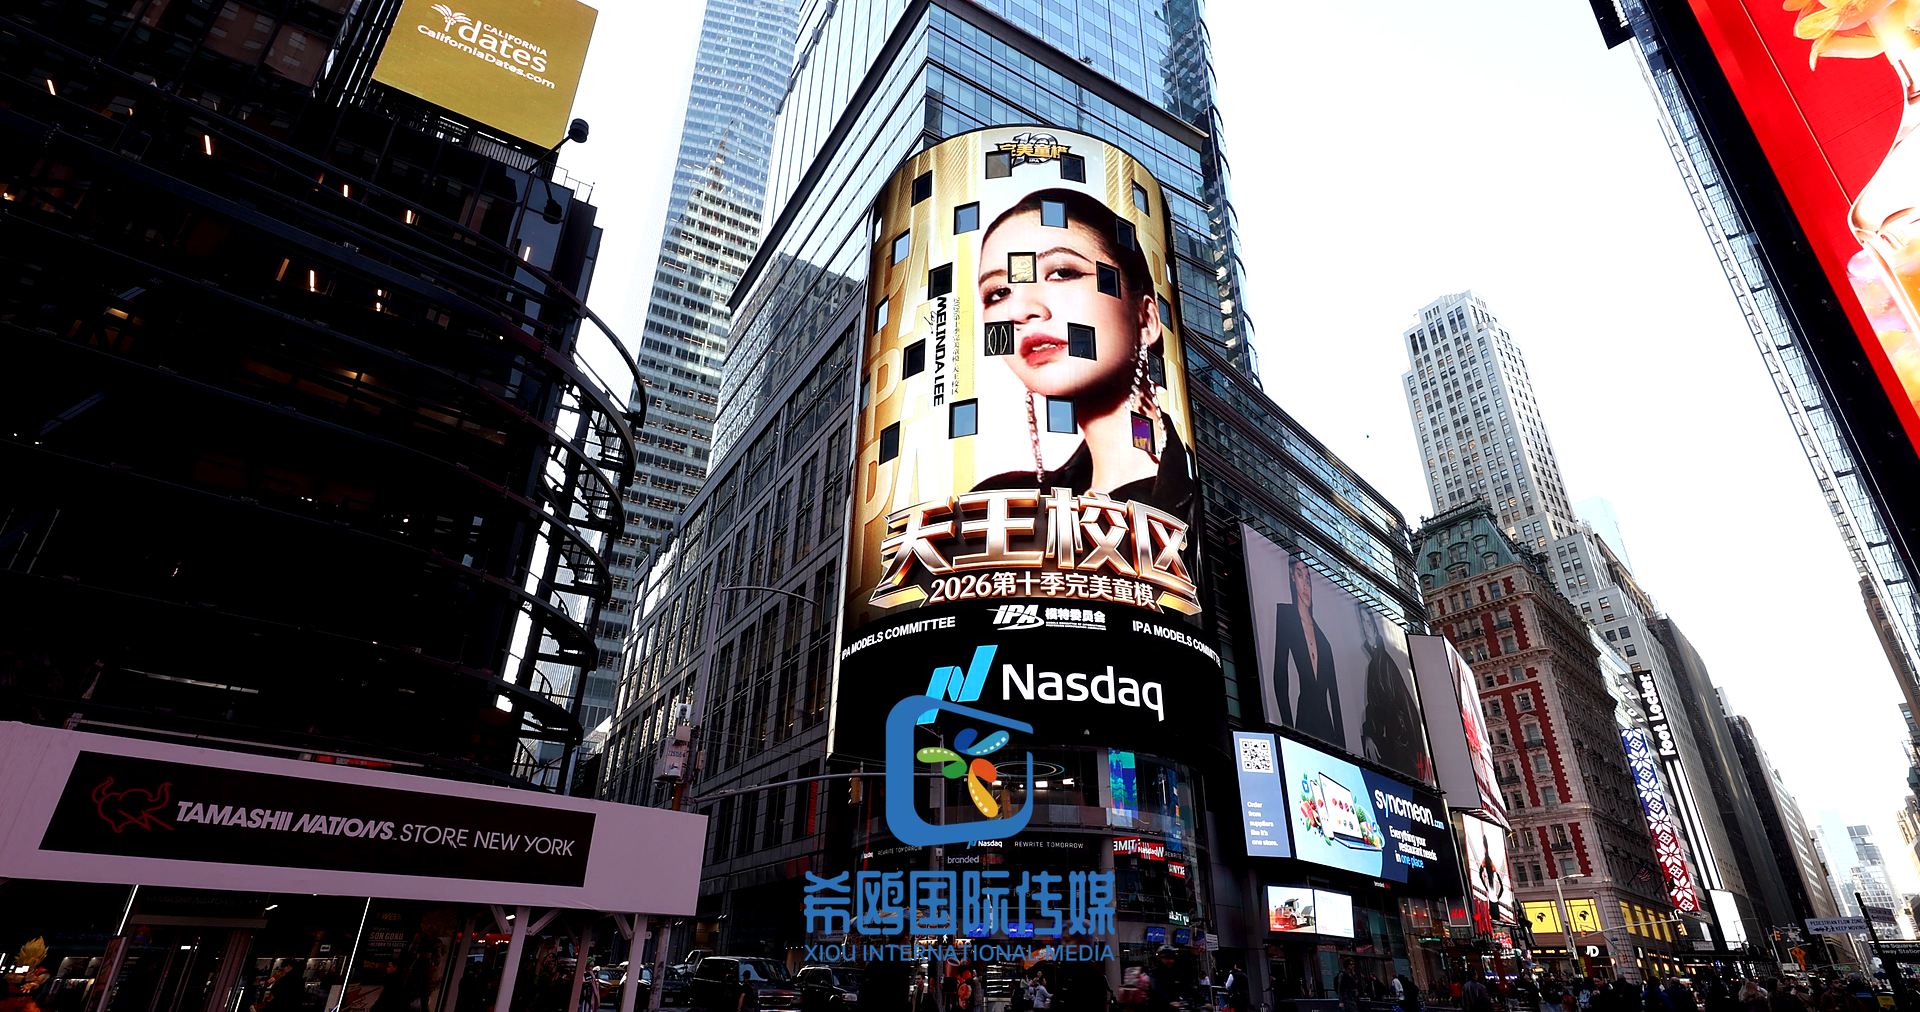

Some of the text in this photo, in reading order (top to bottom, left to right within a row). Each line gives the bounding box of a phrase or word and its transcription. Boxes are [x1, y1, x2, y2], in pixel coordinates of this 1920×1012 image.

[417, 24, 556, 89] CaliforniaDates.com
[458, 20, 548, 73] dates
[483, 23, 548, 57] CALIFORNIA
[933, 296, 947, 407] MELINDA LEE
[871, 487, 1197, 593] 天王校区
[930, 570, 1156, 610] 2026第十季完美童模
[850, 632, 884, 654] MODELS
[884, 616, 956, 640] COMMITTEE
[990, 604, 1042, 627] IPA
[1132, 619, 1152, 634] IPA
[1153, 624, 1192, 647] MODELS
[1002, 664, 1165, 722] Nasdaq
[176, 800, 575, 857] TAMASHII NATIONS STORE NEW YORK
[977, 840, 1003, 848] Nasdaq
[1046, 841, 1084, 849] TOMORROW
[947, 854, 980, 864] branded
